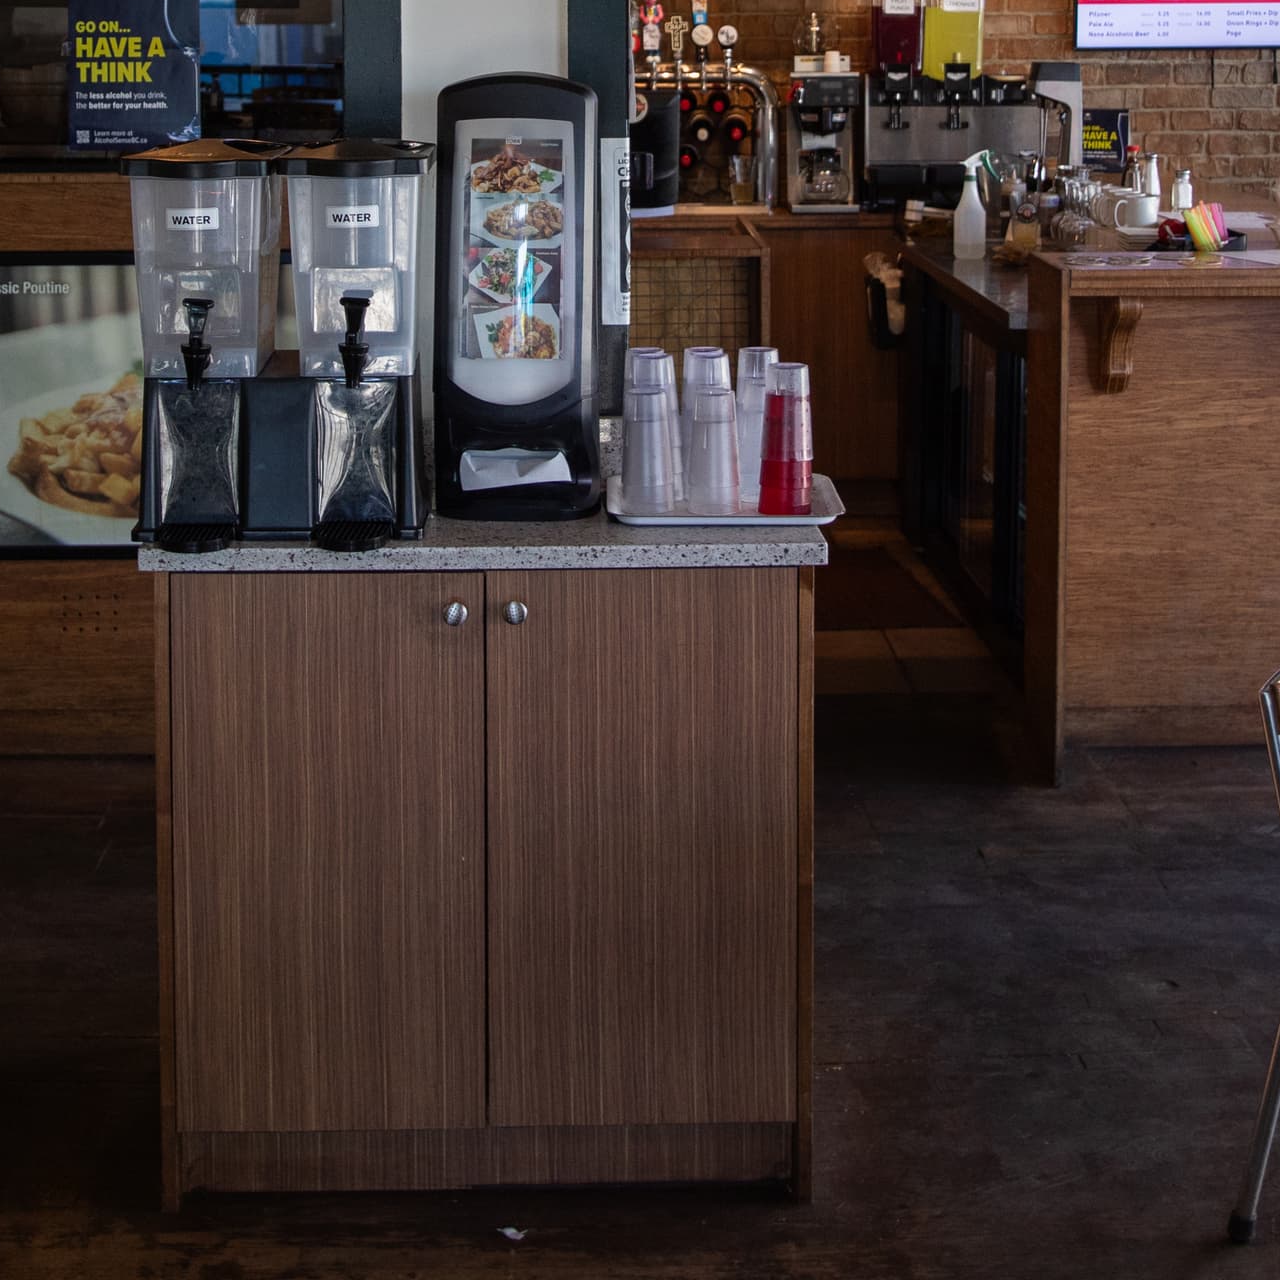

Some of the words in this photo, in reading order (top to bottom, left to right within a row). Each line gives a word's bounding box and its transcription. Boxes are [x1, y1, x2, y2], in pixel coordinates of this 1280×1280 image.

[75, 21, 96, 33] GO
[99, 21, 131, 33] ON...
[75, 36, 143, 58] HAVE
[147, 36, 165, 58] A
[76, 62, 152, 83] THINK
[75, 91, 88, 99] The
[89, 91, 104, 99] less
[105, 91, 132, 99] alcohol
[133, 91, 147, 100] you
[148, 91, 167, 100] drink,
[76, 101, 87, 109] the
[89, 101, 111, 109] better
[112, 101, 124, 109] for
[125, 101, 141, 110] your
[143, 101, 168, 109] health.
[1082, 132, 1108, 140] HAVE
[1110, 132, 1117, 140] A
[1083, 140, 1112, 149] THINK
[172, 215, 211, 225] WATER
[332, 213, 371, 223] WATER
[23, 281, 70, 294] Poutine
